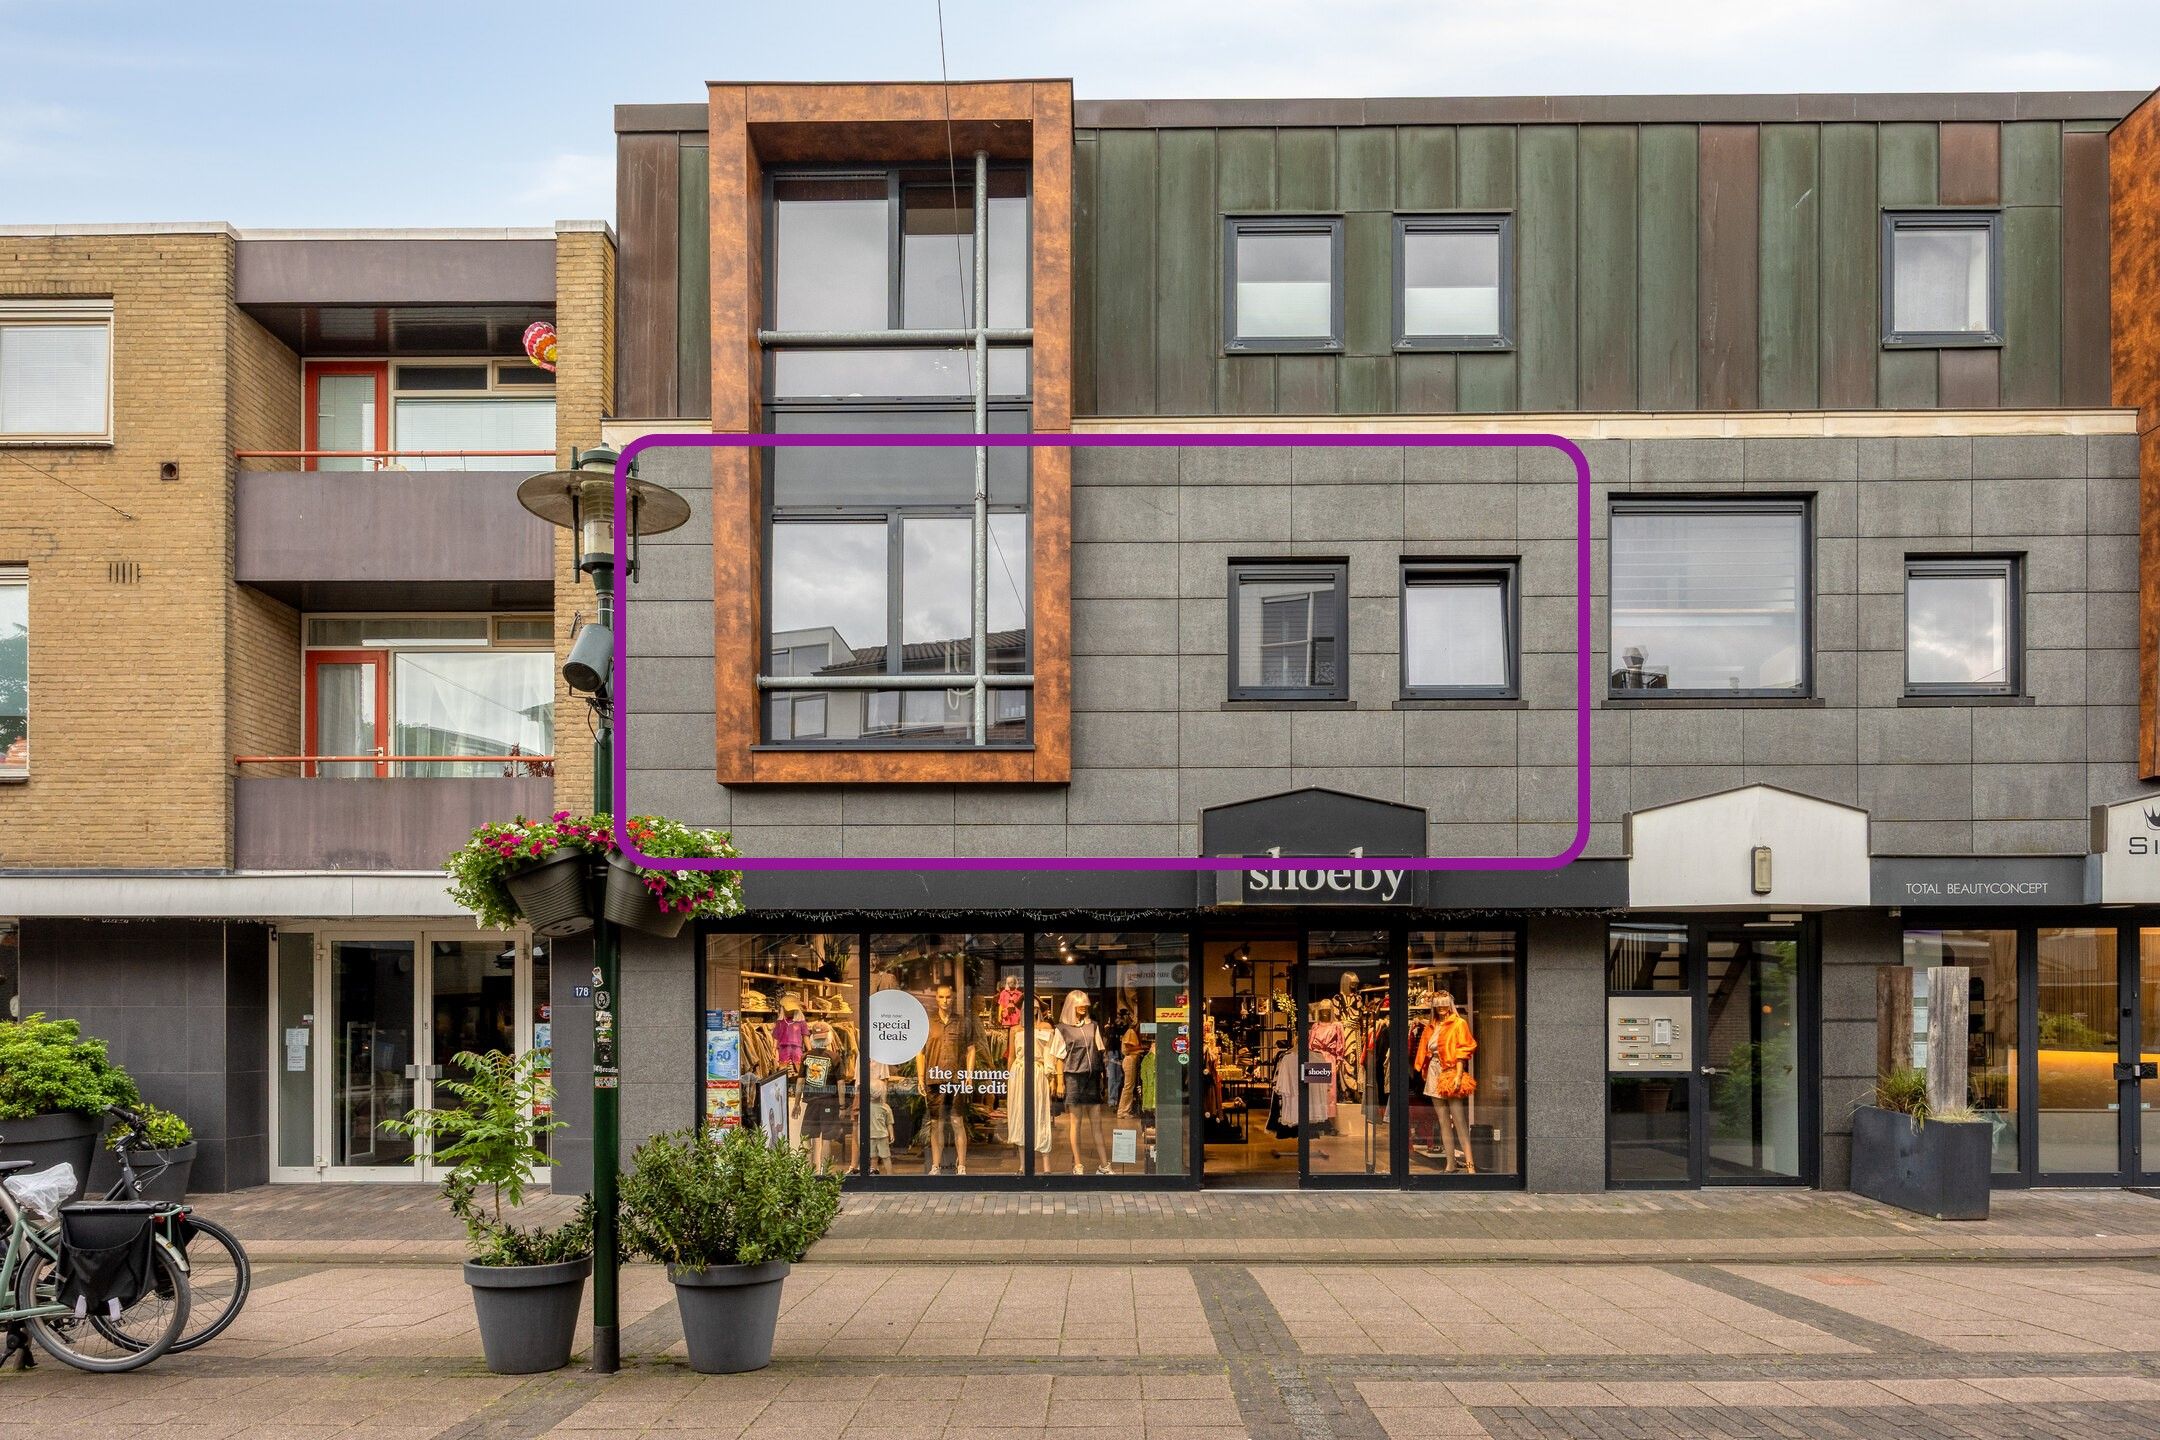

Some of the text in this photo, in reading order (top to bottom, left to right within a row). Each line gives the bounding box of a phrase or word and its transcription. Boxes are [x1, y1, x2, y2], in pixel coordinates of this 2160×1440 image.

[1906, 883, 2048, 894] TOTAL BEAUTYCONCEPT
[575, 987, 589, 996] 178
[872, 1020, 910, 1031] special
[879, 1031, 908, 1041] deals
[928, 1066, 953, 1080] the
[1308, 1068, 1331, 1077] shoeby
[939, 1081, 1008, 1097] style edit
